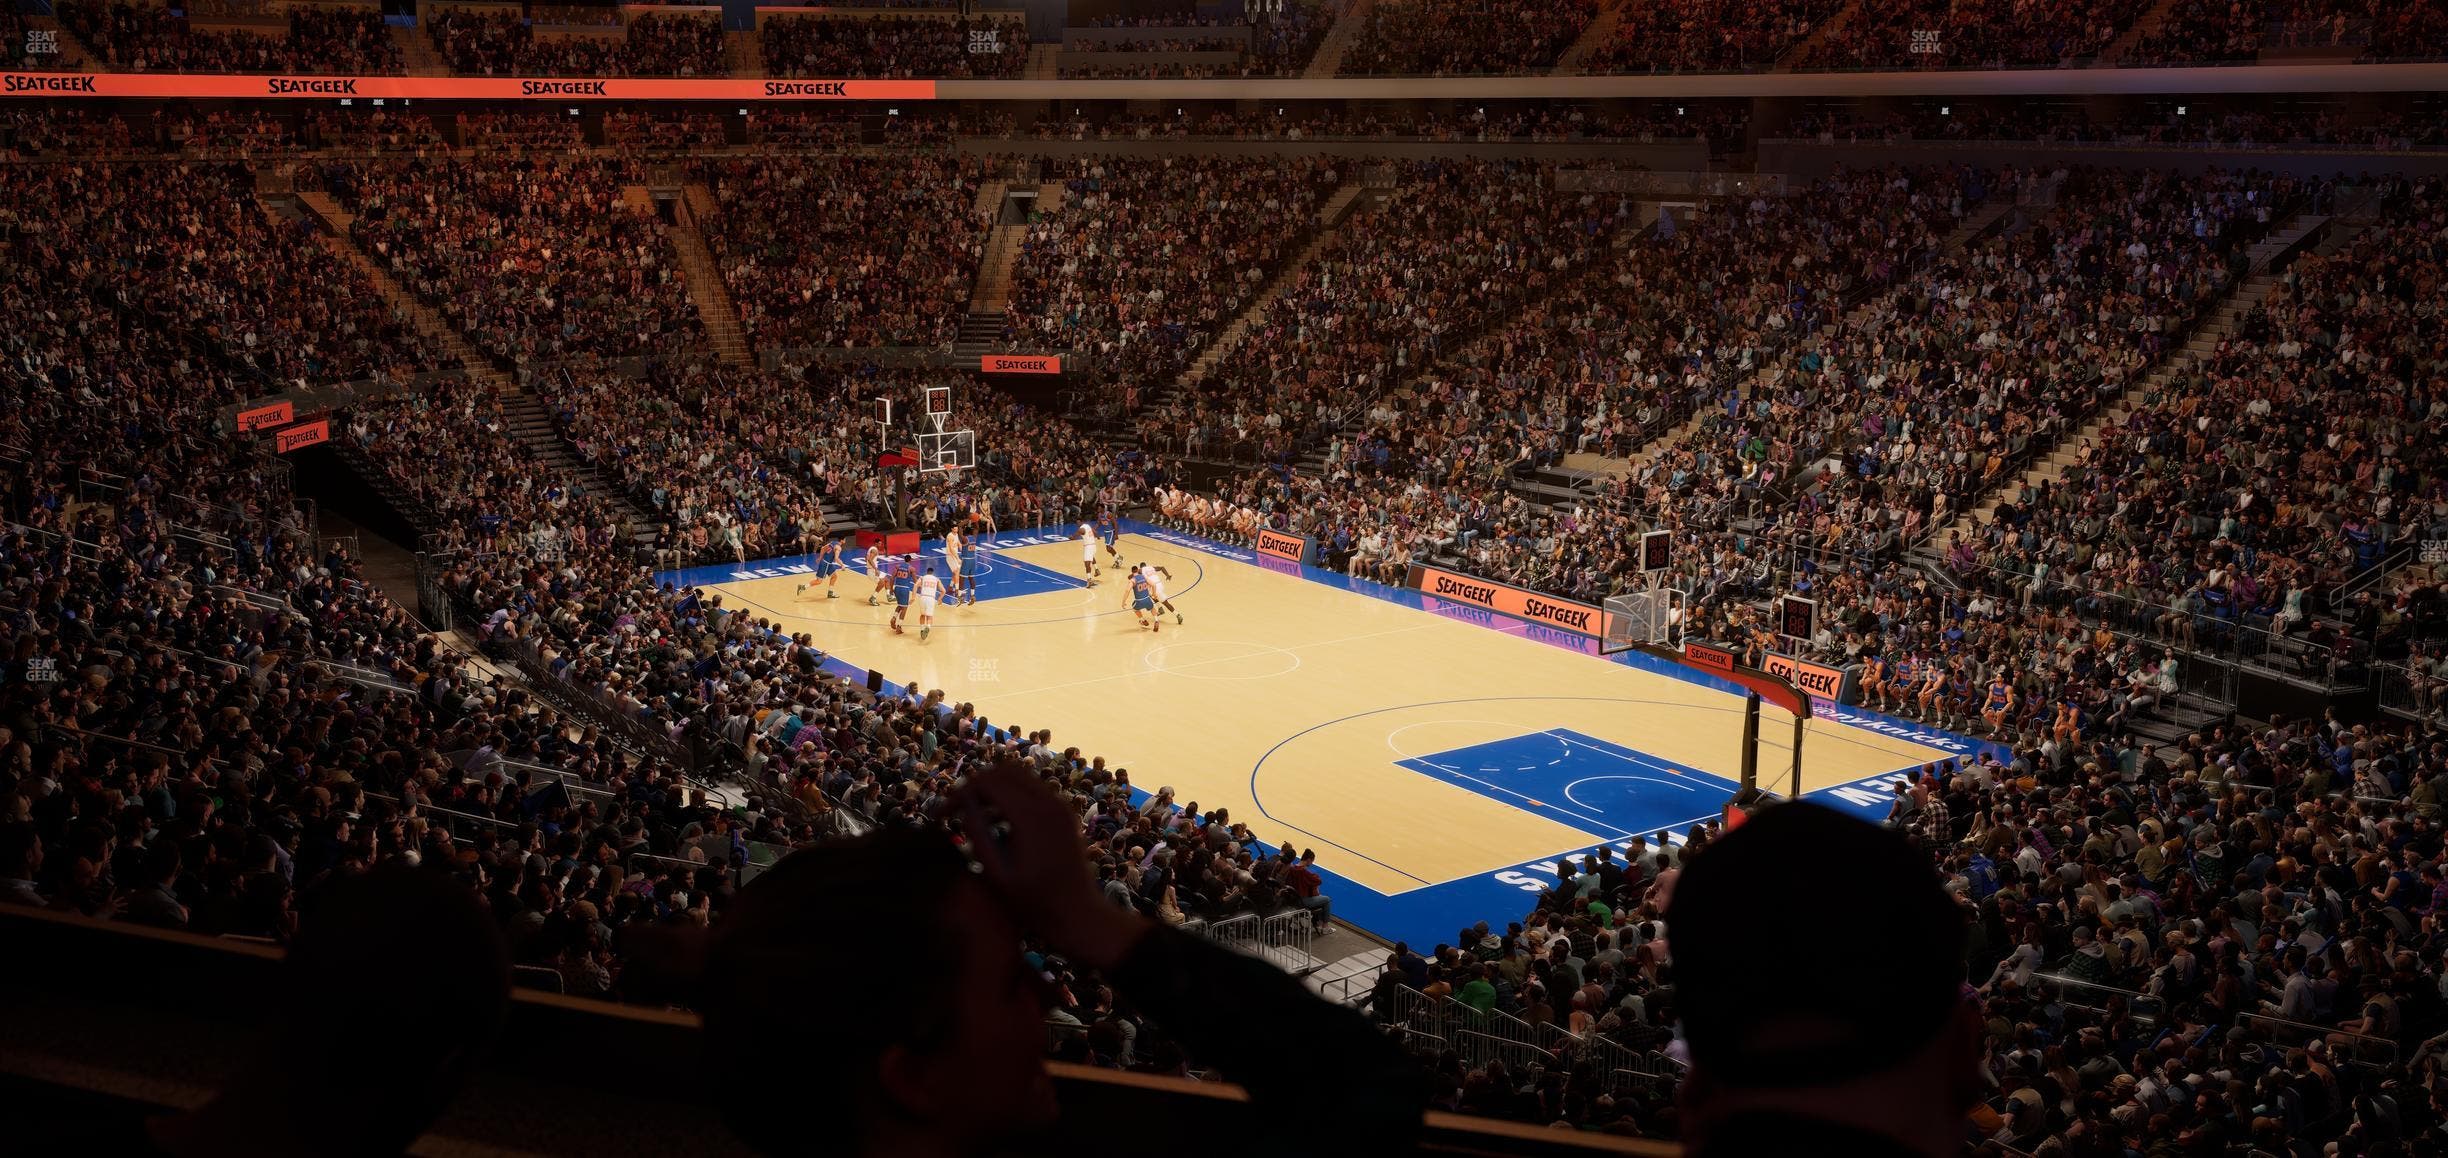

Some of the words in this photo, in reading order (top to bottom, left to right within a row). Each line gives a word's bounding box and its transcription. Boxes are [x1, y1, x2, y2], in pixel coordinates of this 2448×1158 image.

[4, 75, 97, 92] SEATGEEK
[268, 78, 358, 95] SEATGEEK
[522, 80, 607, 96] SEATGEEK
[764, 82, 847, 96] SEATGEEK
[995, 359, 1047, 371] SEATGEEK
[1259, 535, 1302, 559] SEATGEEK
[729, 564, 815, 580] NEW
[1435, 576, 1497, 607] SEATGEEK
[1523, 598, 1592, 631] SEATGEEK
[1690, 648, 1728, 667] SEATGEEK
